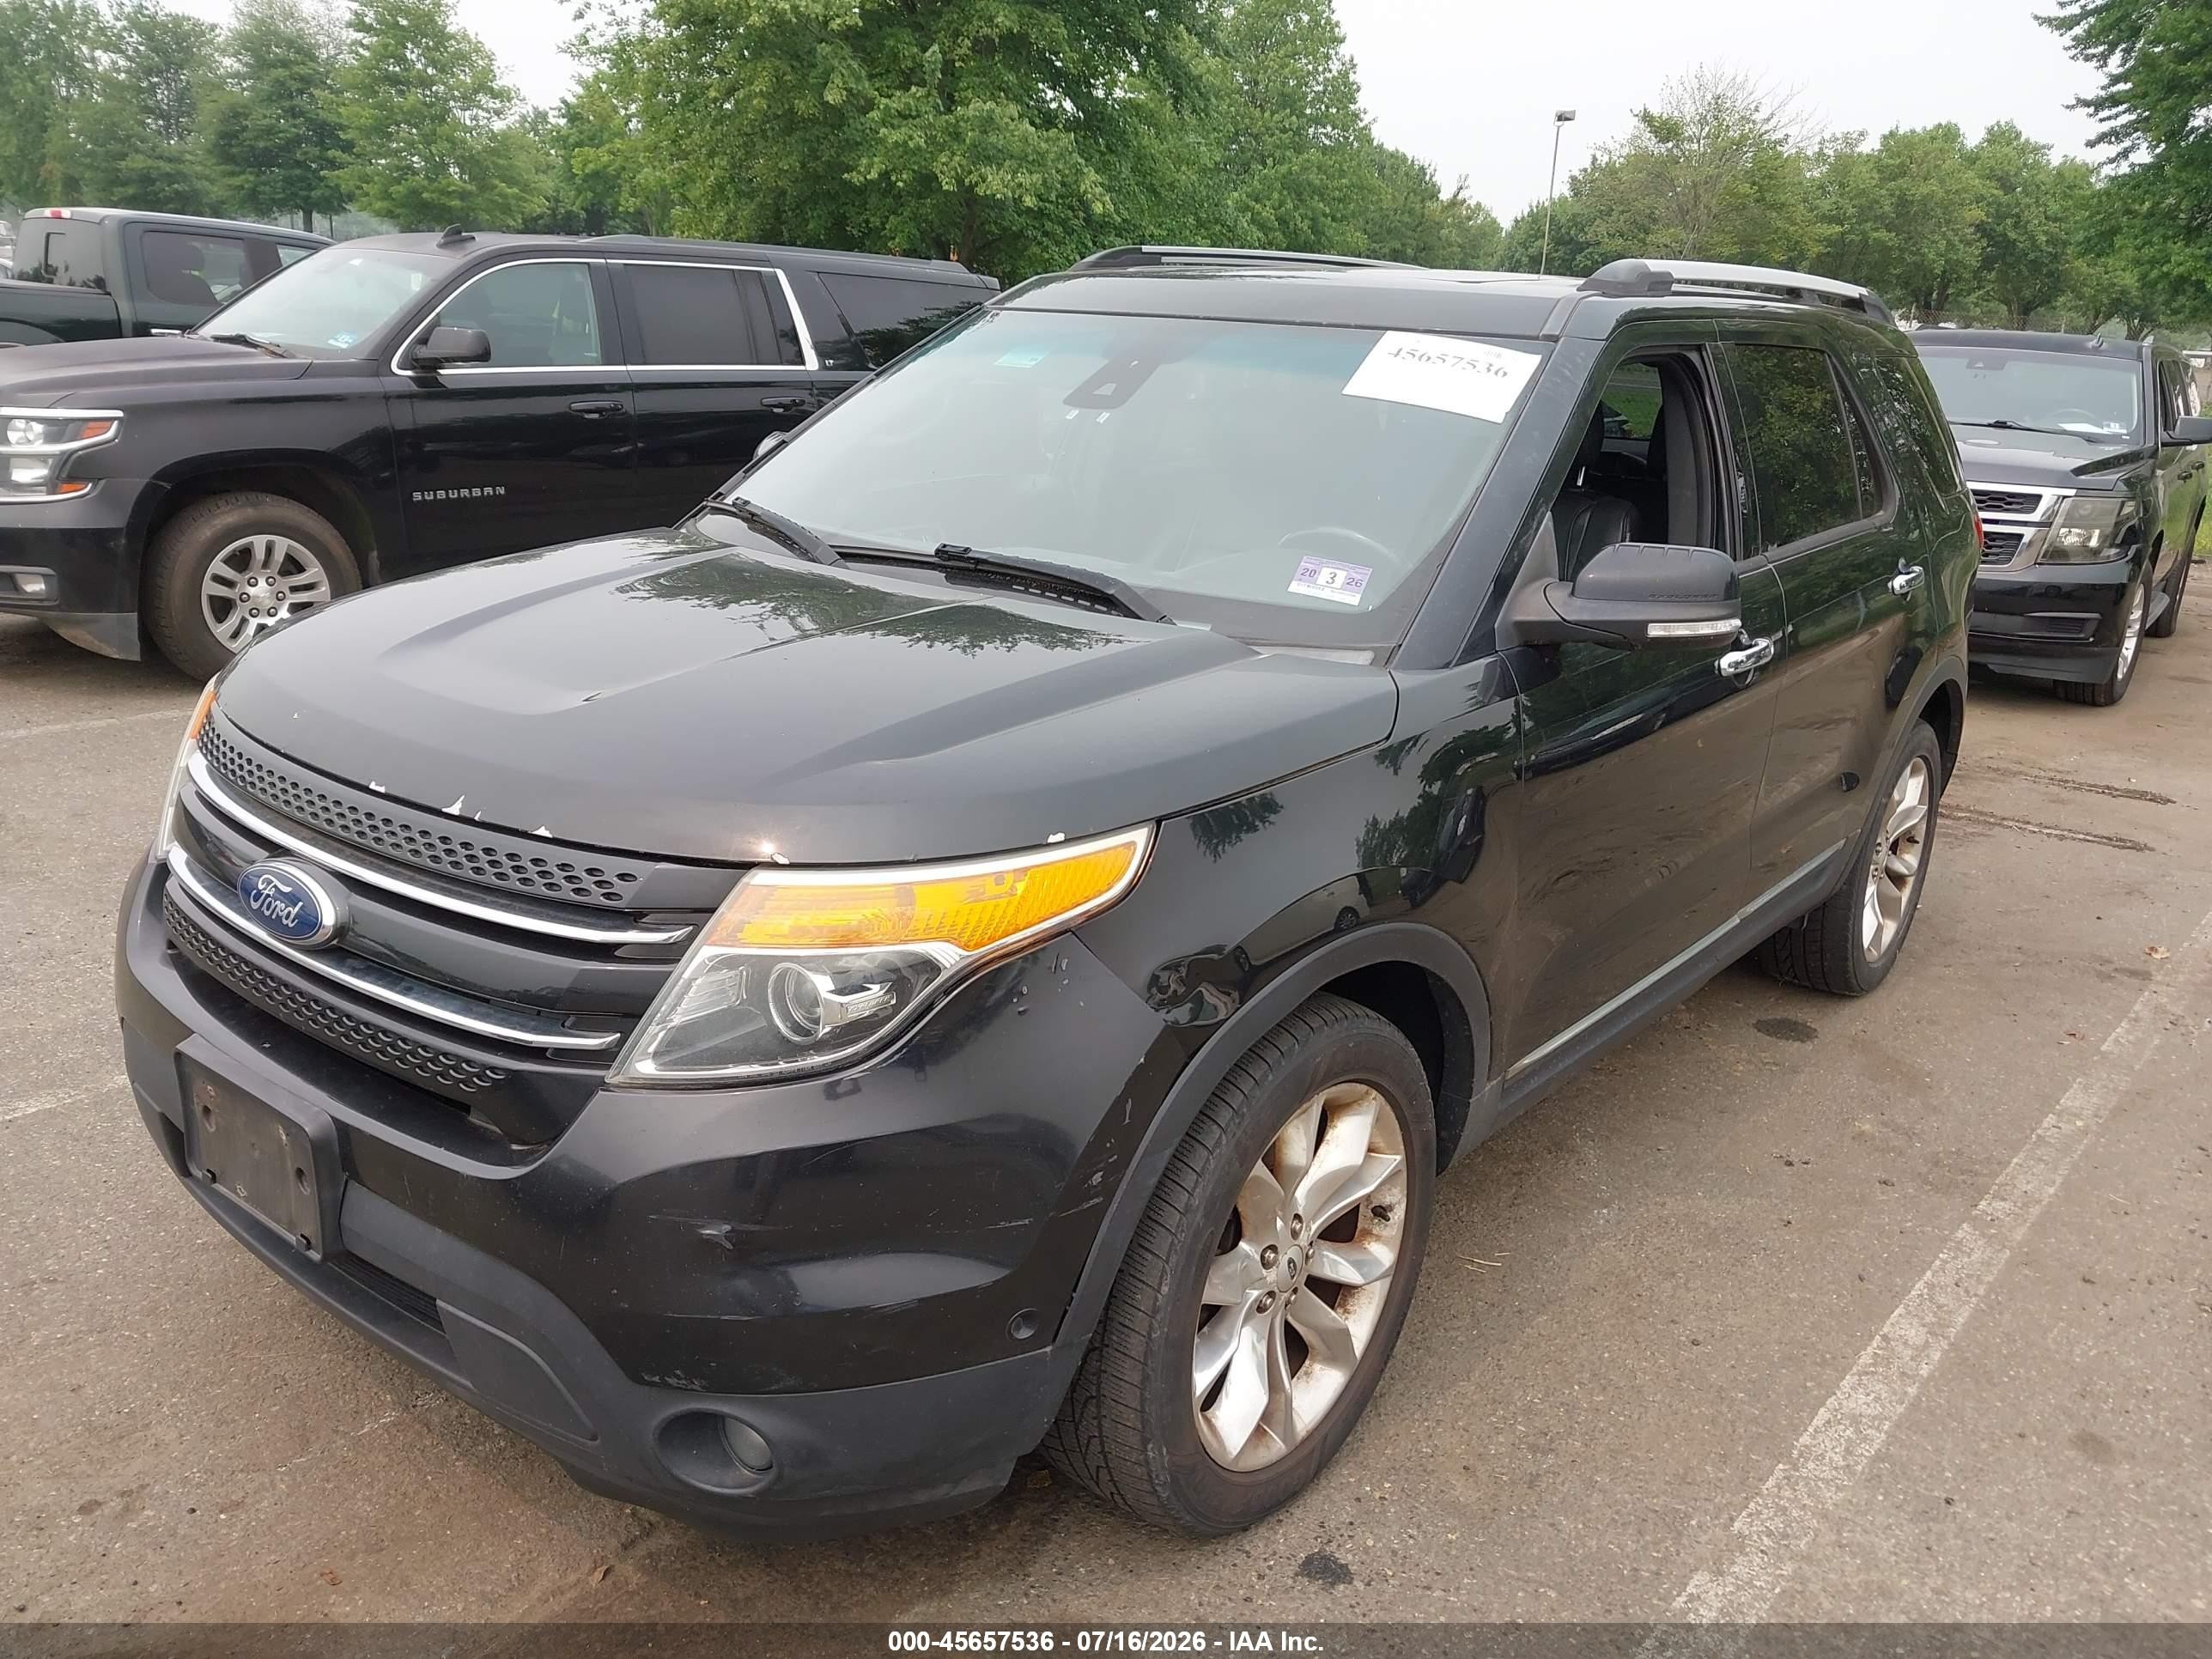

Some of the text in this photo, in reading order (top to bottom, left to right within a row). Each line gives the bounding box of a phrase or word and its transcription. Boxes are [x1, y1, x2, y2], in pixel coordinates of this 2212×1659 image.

[1388, 347, 1508, 378] 45657536
[412, 486, 506, 501] SUBURBAN
[1300, 568, 1364, 588] 20 3 26
[249, 874, 303, 927] Ford
